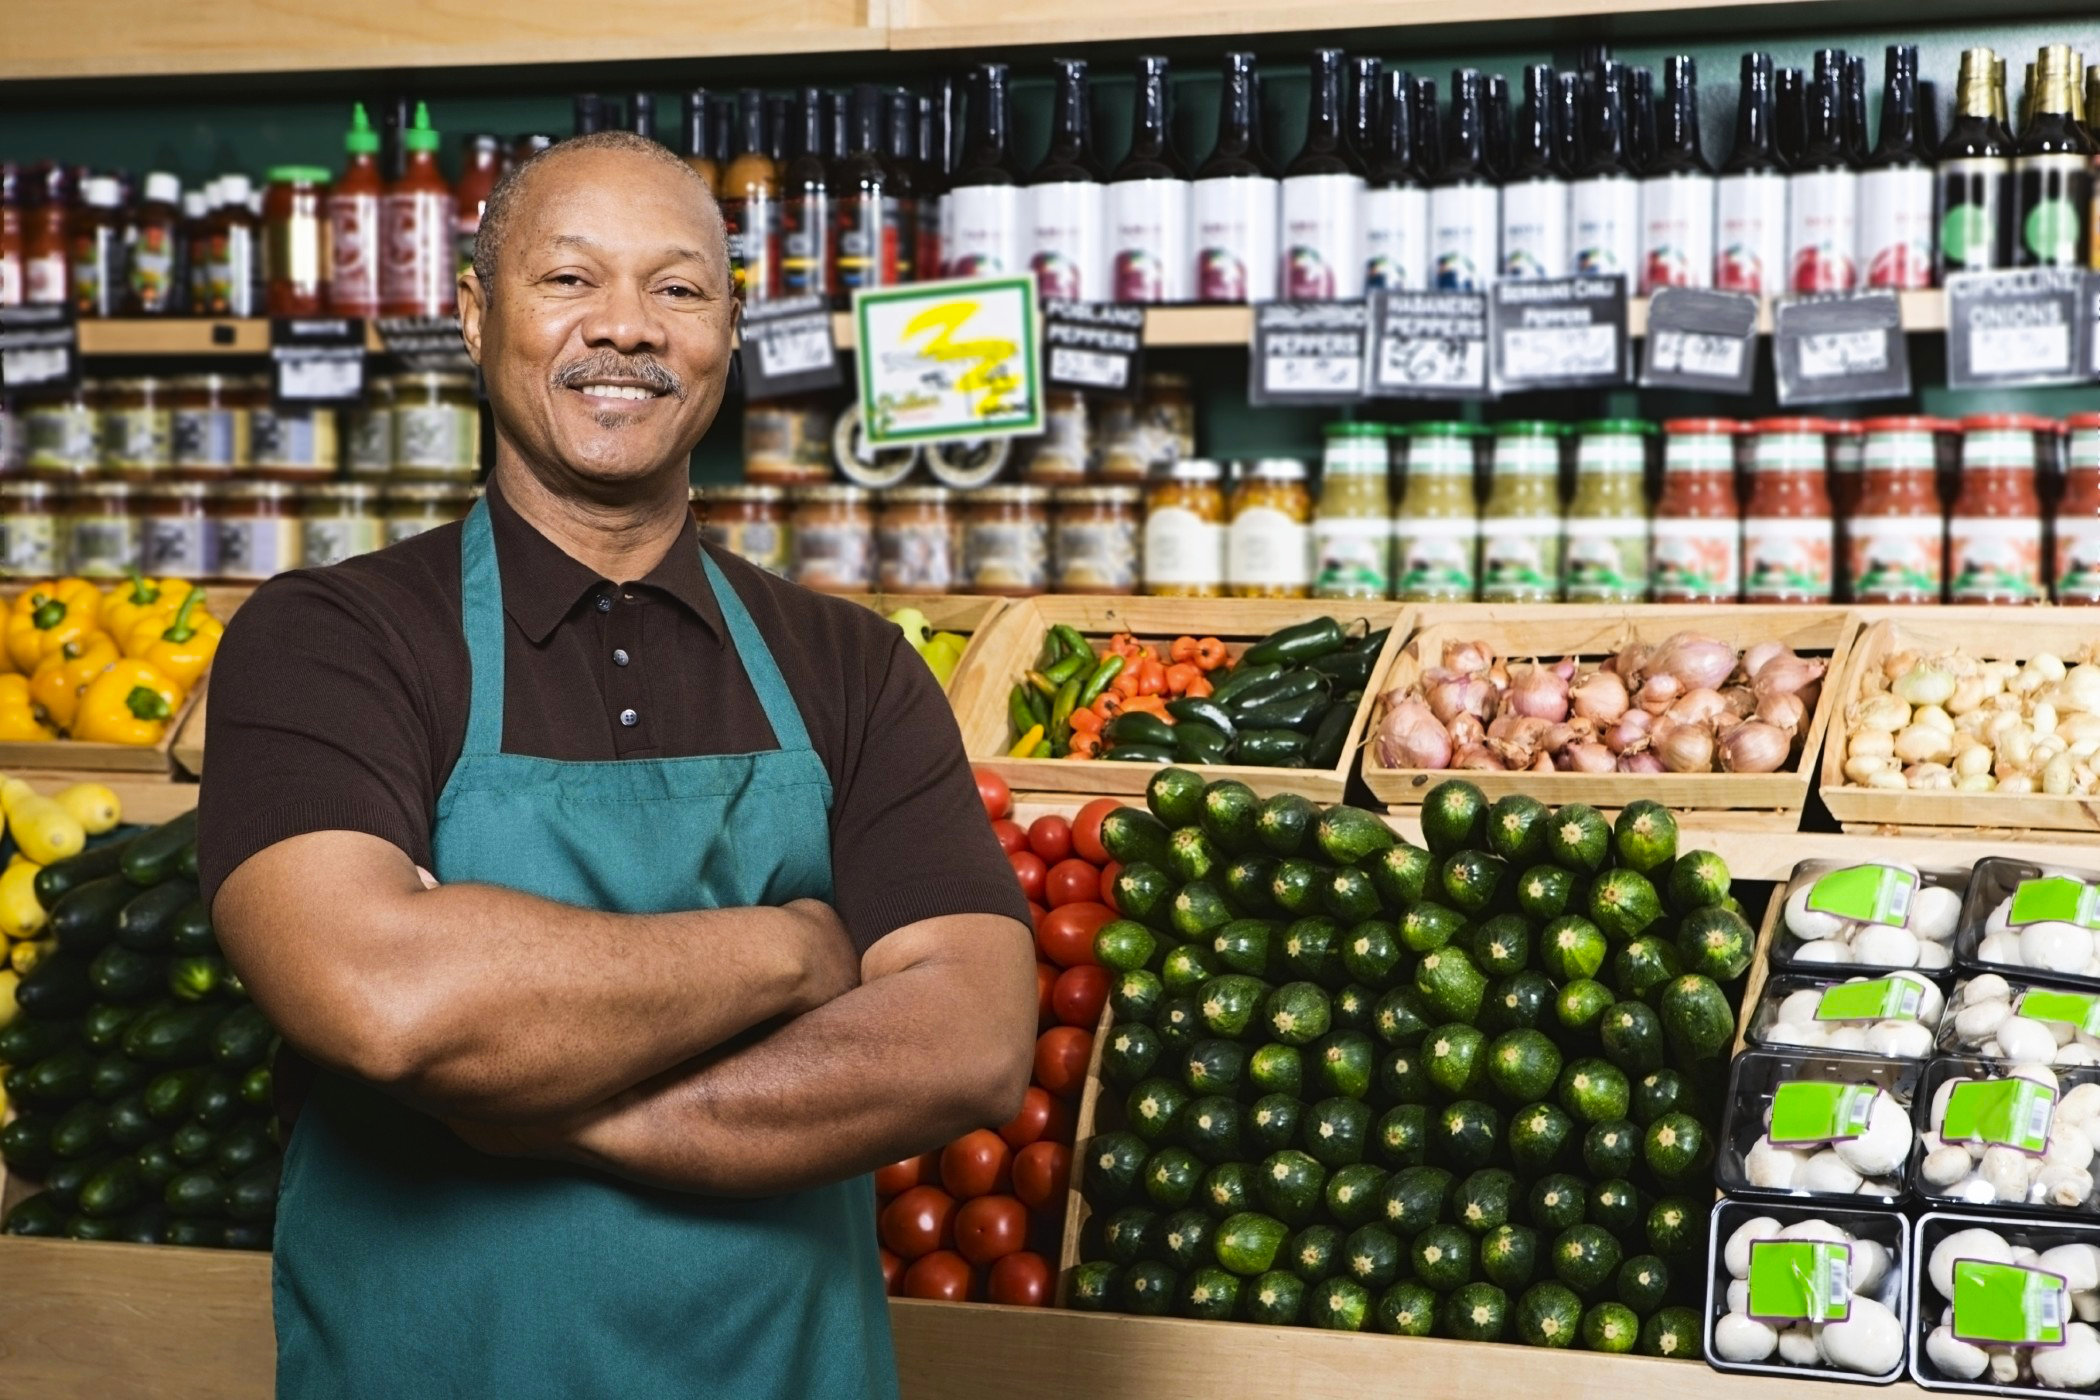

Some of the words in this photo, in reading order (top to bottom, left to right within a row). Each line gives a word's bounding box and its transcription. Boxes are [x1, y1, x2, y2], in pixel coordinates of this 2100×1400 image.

[1953, 270, 2079, 297] CIPOLLINE
[1045, 300, 1142, 327] POBLANO
[1386, 295, 1483, 313] HABANERO
[1970, 305, 2062, 326] ONIONS
[1047, 325, 1138, 350] PEPPERS
[1385, 317, 1483, 336] PEPPERS
[1265, 332, 1358, 356] PEPPERS
